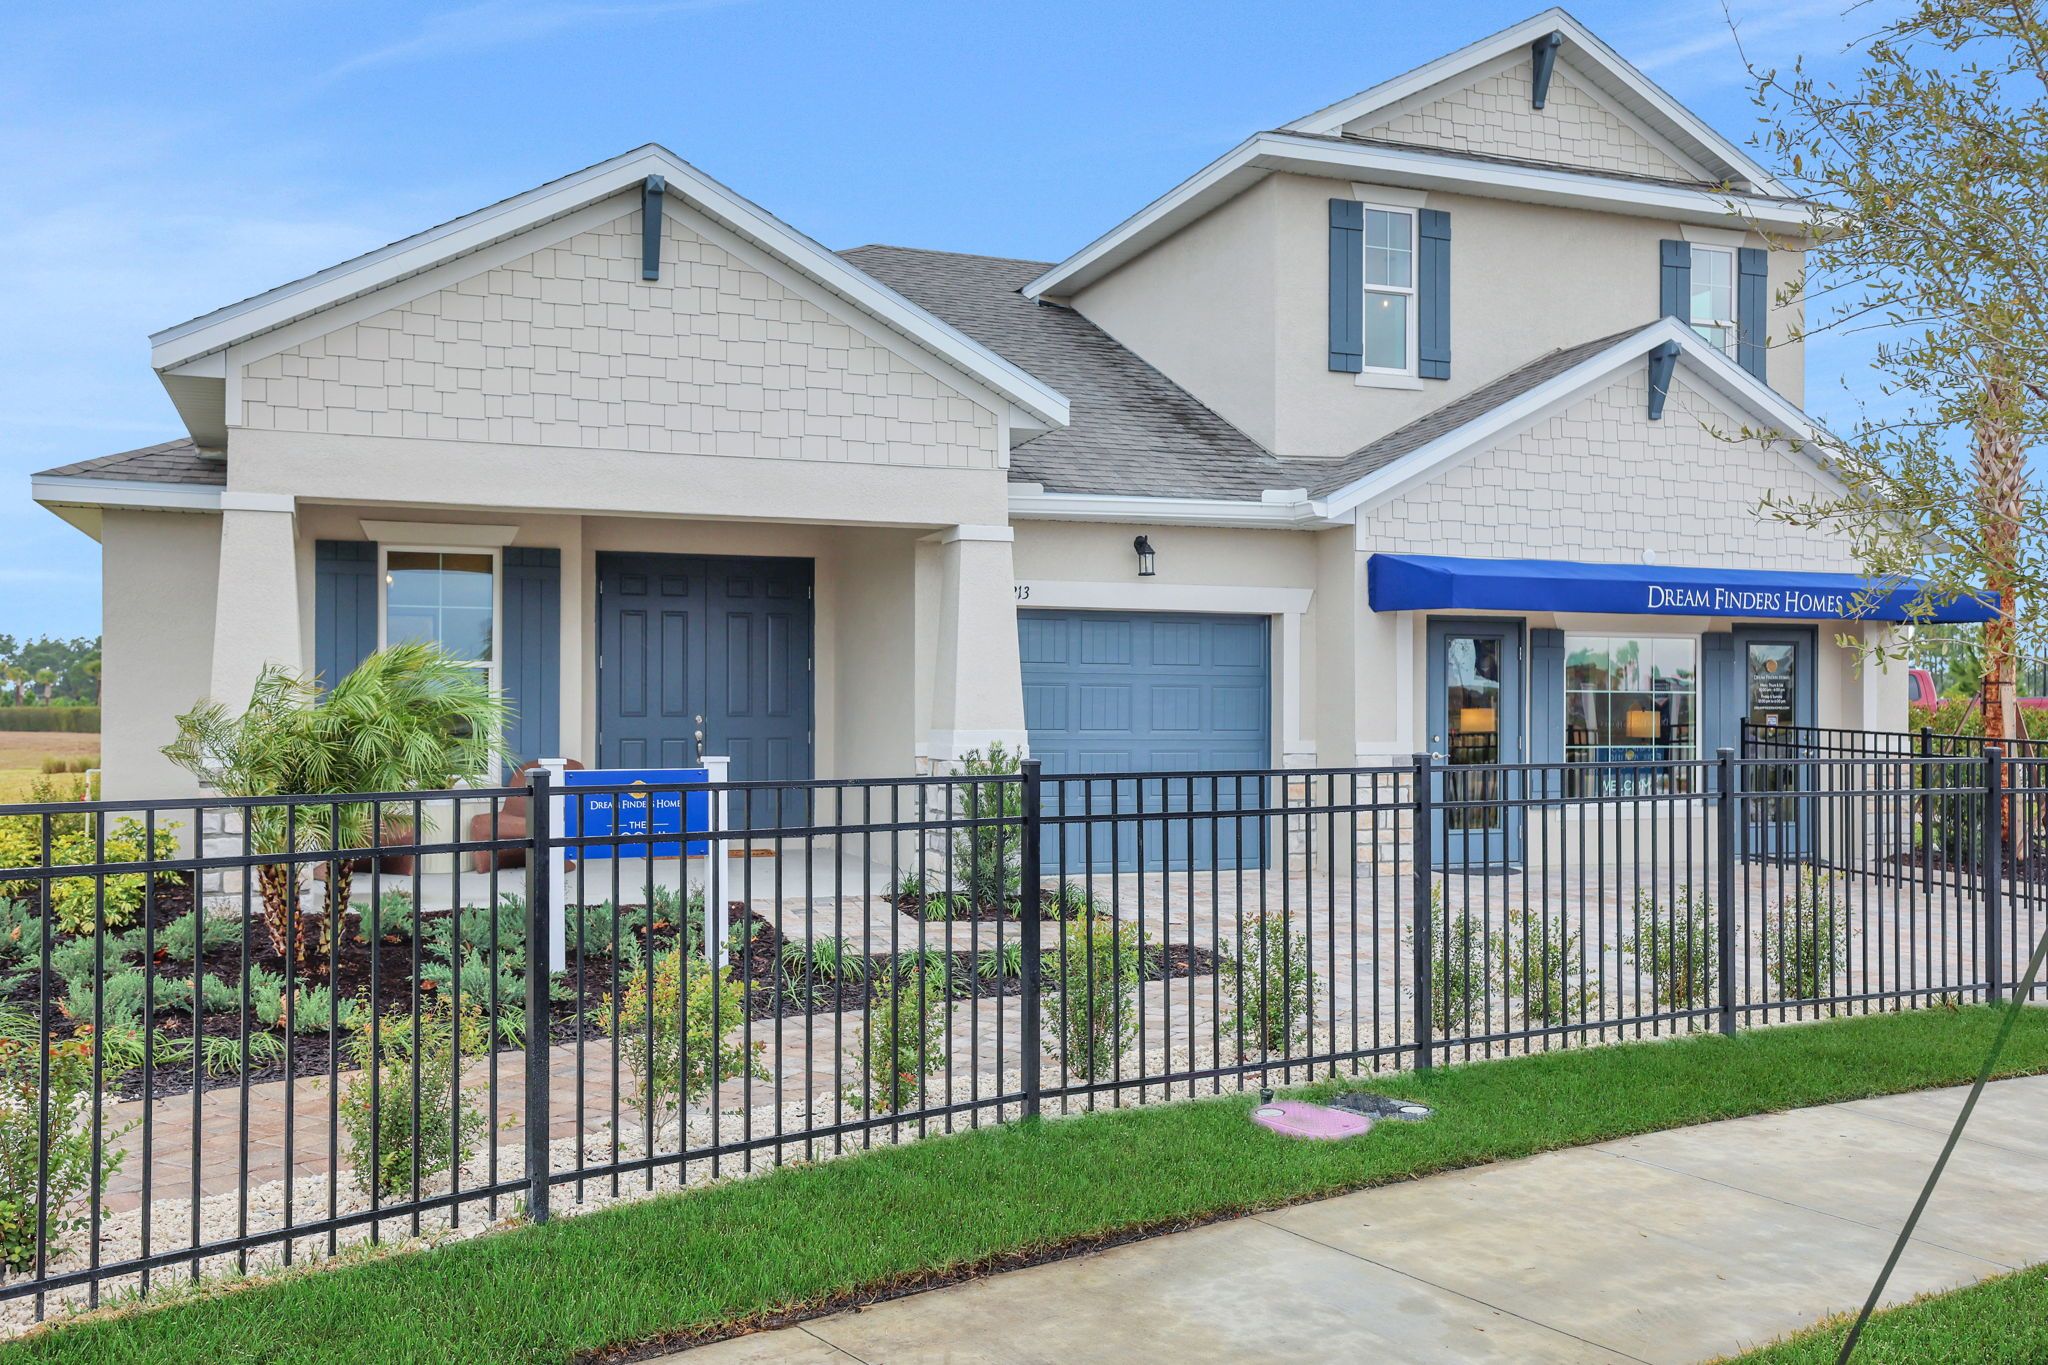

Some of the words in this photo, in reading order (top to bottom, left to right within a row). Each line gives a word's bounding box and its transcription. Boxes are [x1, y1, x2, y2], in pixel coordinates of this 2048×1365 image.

[1014, 585, 1030, 600] 13
[1647, 585, 1711, 609] DREAM
[1714, 587, 1781, 611] FINDERS
[1784, 591, 1844, 613] HOMES
[590, 800, 620, 810] DREA
[628, 820, 647, 829] THE
